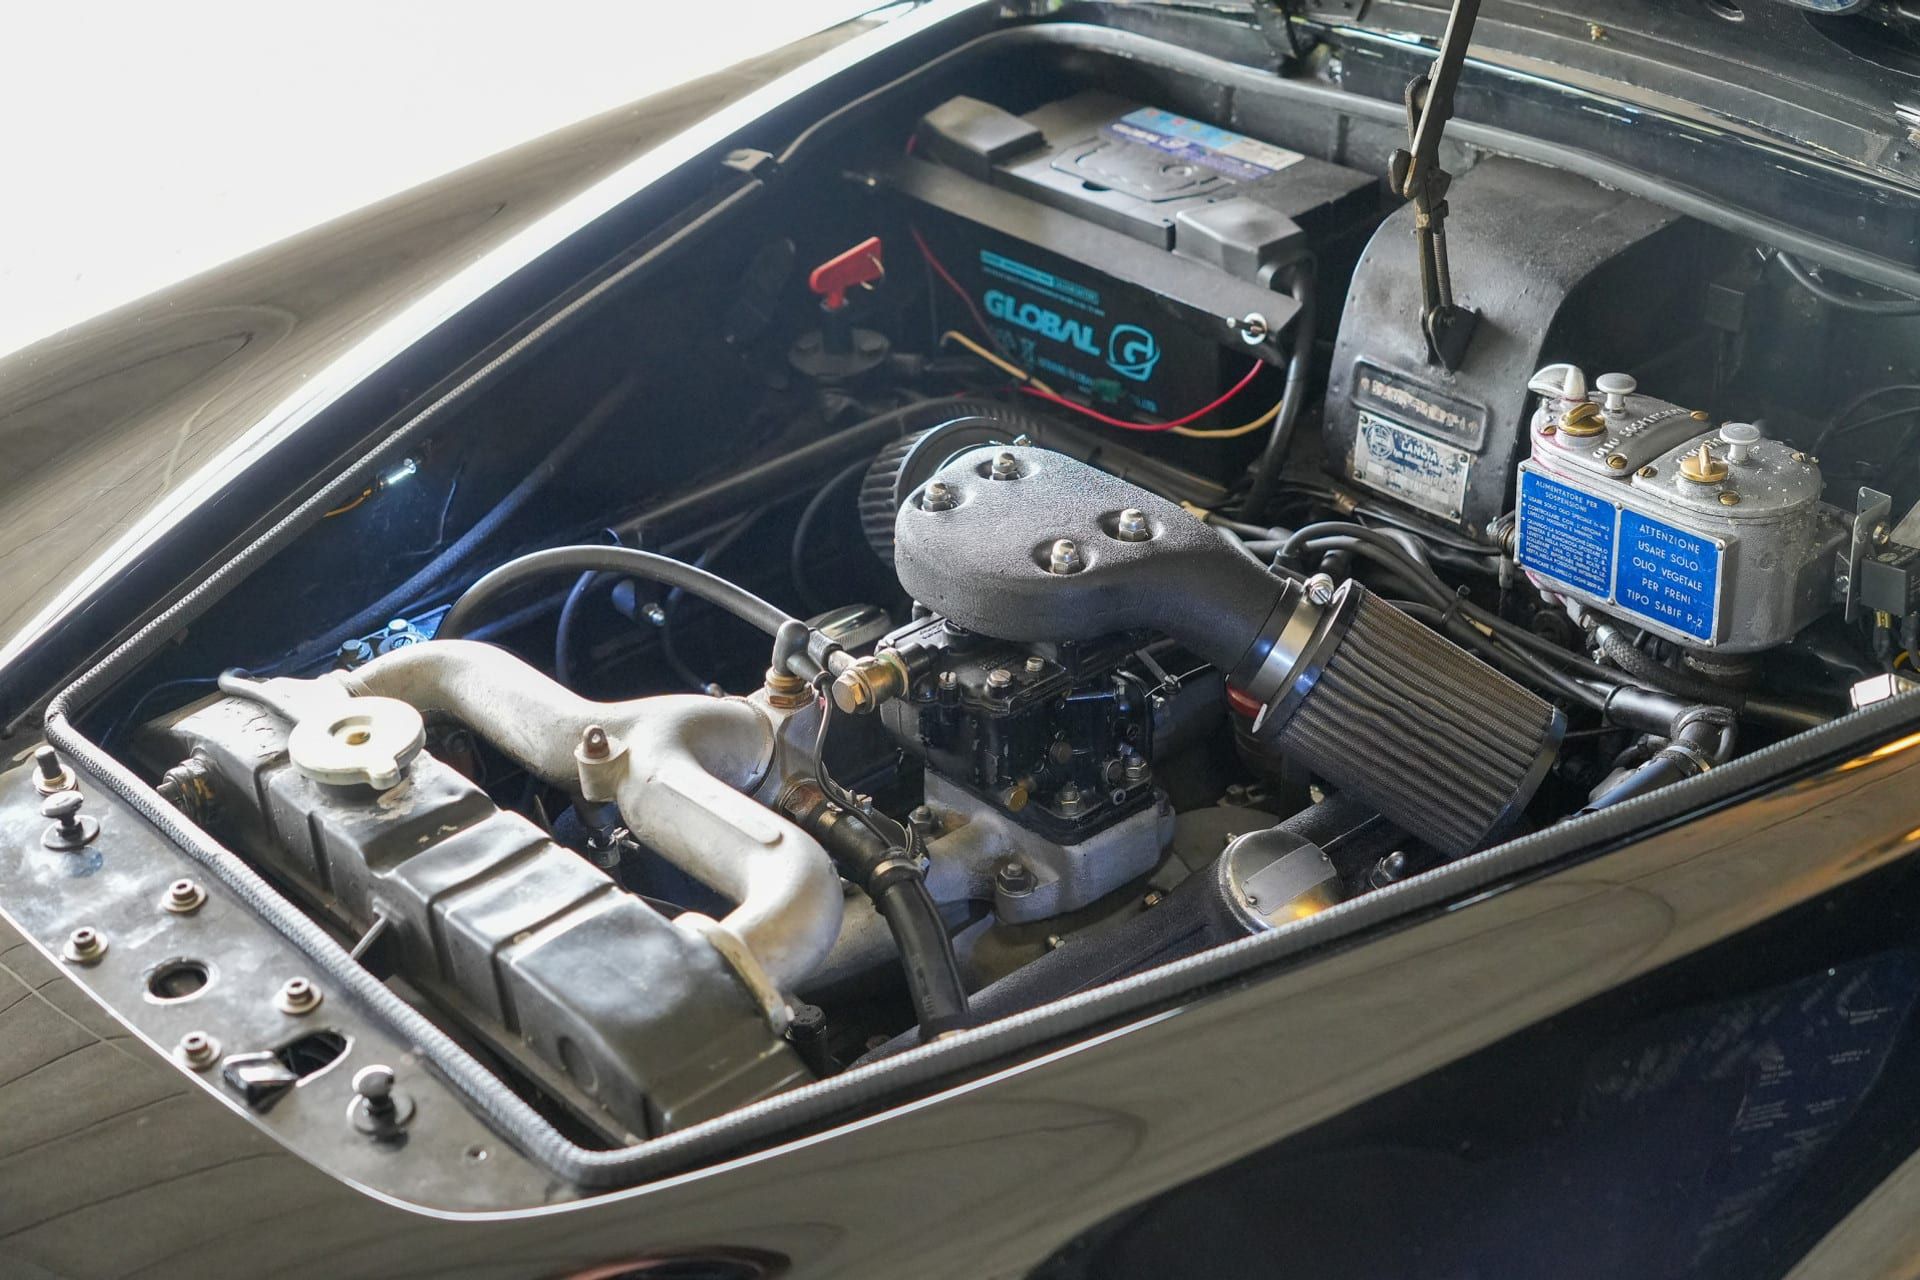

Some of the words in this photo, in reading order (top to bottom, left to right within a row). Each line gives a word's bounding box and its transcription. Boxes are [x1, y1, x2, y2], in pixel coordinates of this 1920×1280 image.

[984, 289, 1101, 357] GLOBAL
[1402, 441, 1438, 463] LANCIA
[1536, 480, 1582, 503] ALIMENTATORE
[1586, 500, 1598, 509] PER
[1544, 502, 1557, 511] SOLO
[1545, 491, 1587, 513] SOSPENSIONI
[1639, 524, 1700, 554] ATTENZIONE
[1638, 541, 1666, 559] USARE
[1671, 554, 1699, 571] SOLO
[1632, 557, 1656, 572] OLIO
[1661, 568, 1702, 591] VEGETALE
[1642, 578, 1659, 592] PER
[1665, 587, 1691, 605] FRENI
[1627, 589, 1649, 605] TIPO
[1655, 601, 1682, 618] SABIF
[1687, 613, 1703, 627] P-2
